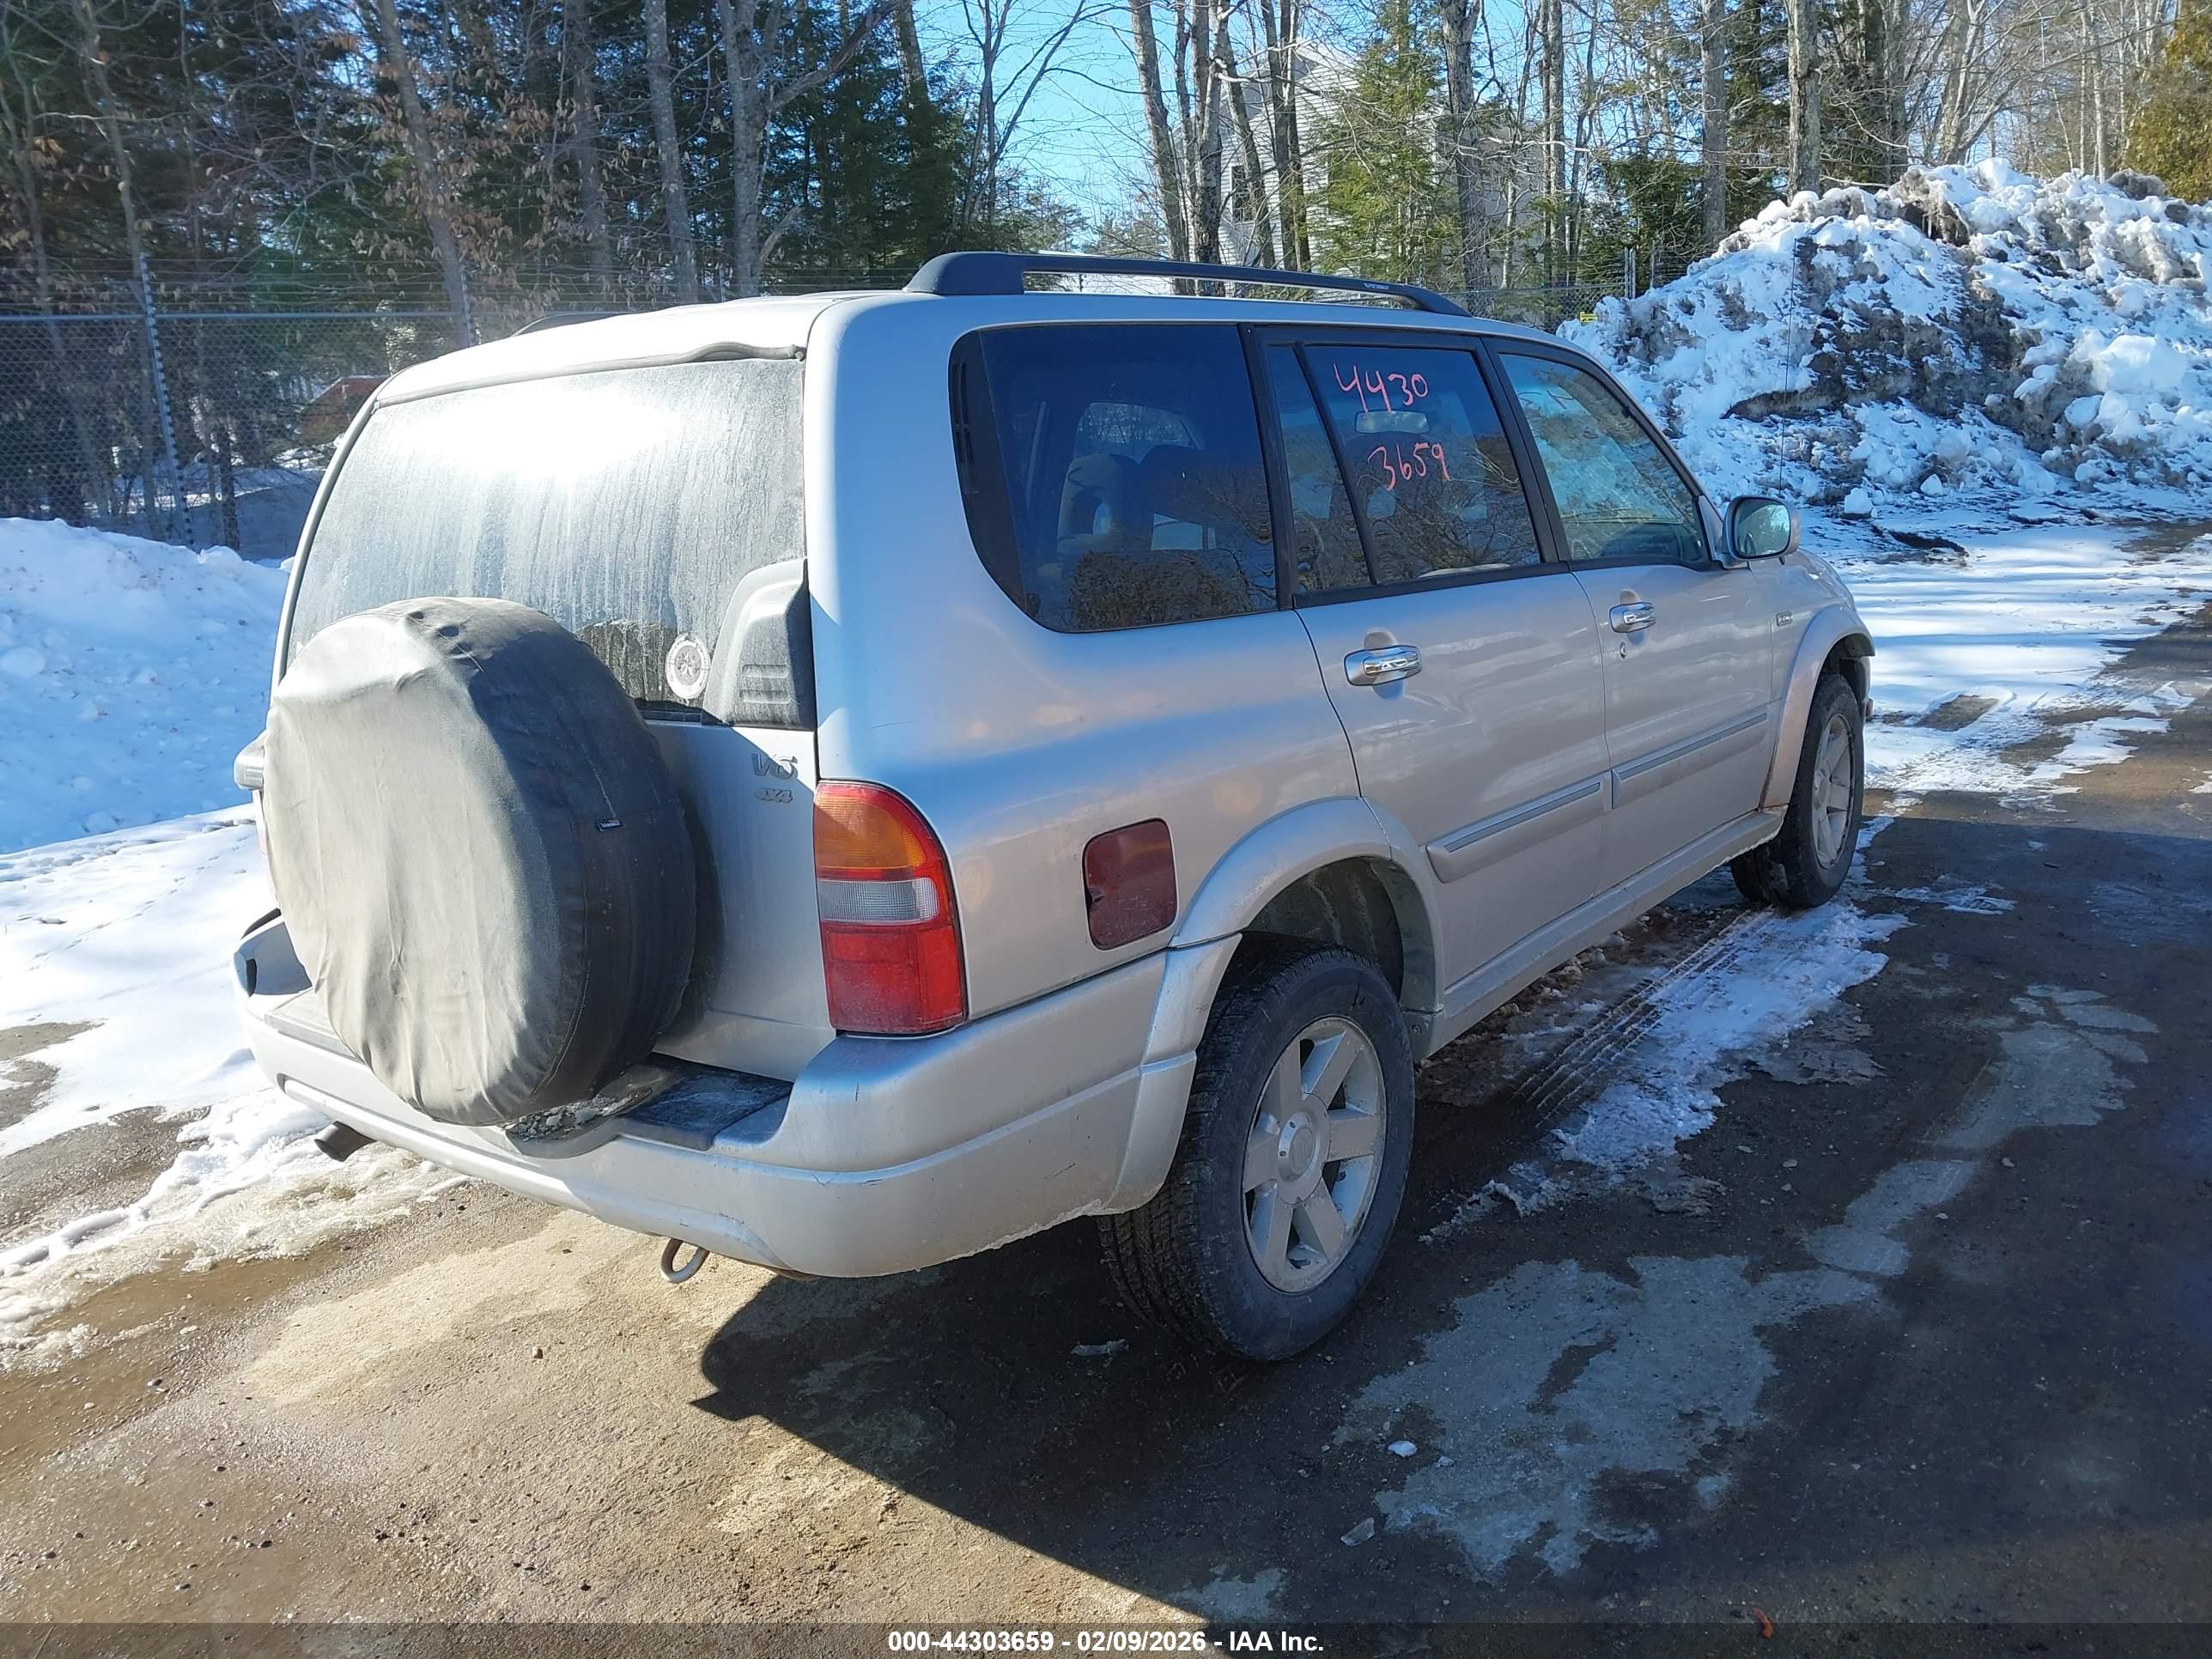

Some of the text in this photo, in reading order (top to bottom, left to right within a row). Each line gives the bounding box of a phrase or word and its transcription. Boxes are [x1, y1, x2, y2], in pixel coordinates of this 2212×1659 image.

[1333, 363, 1429, 412] 4430
[1367, 442, 1451, 491] 3659
[749, 751, 799, 780] V6
